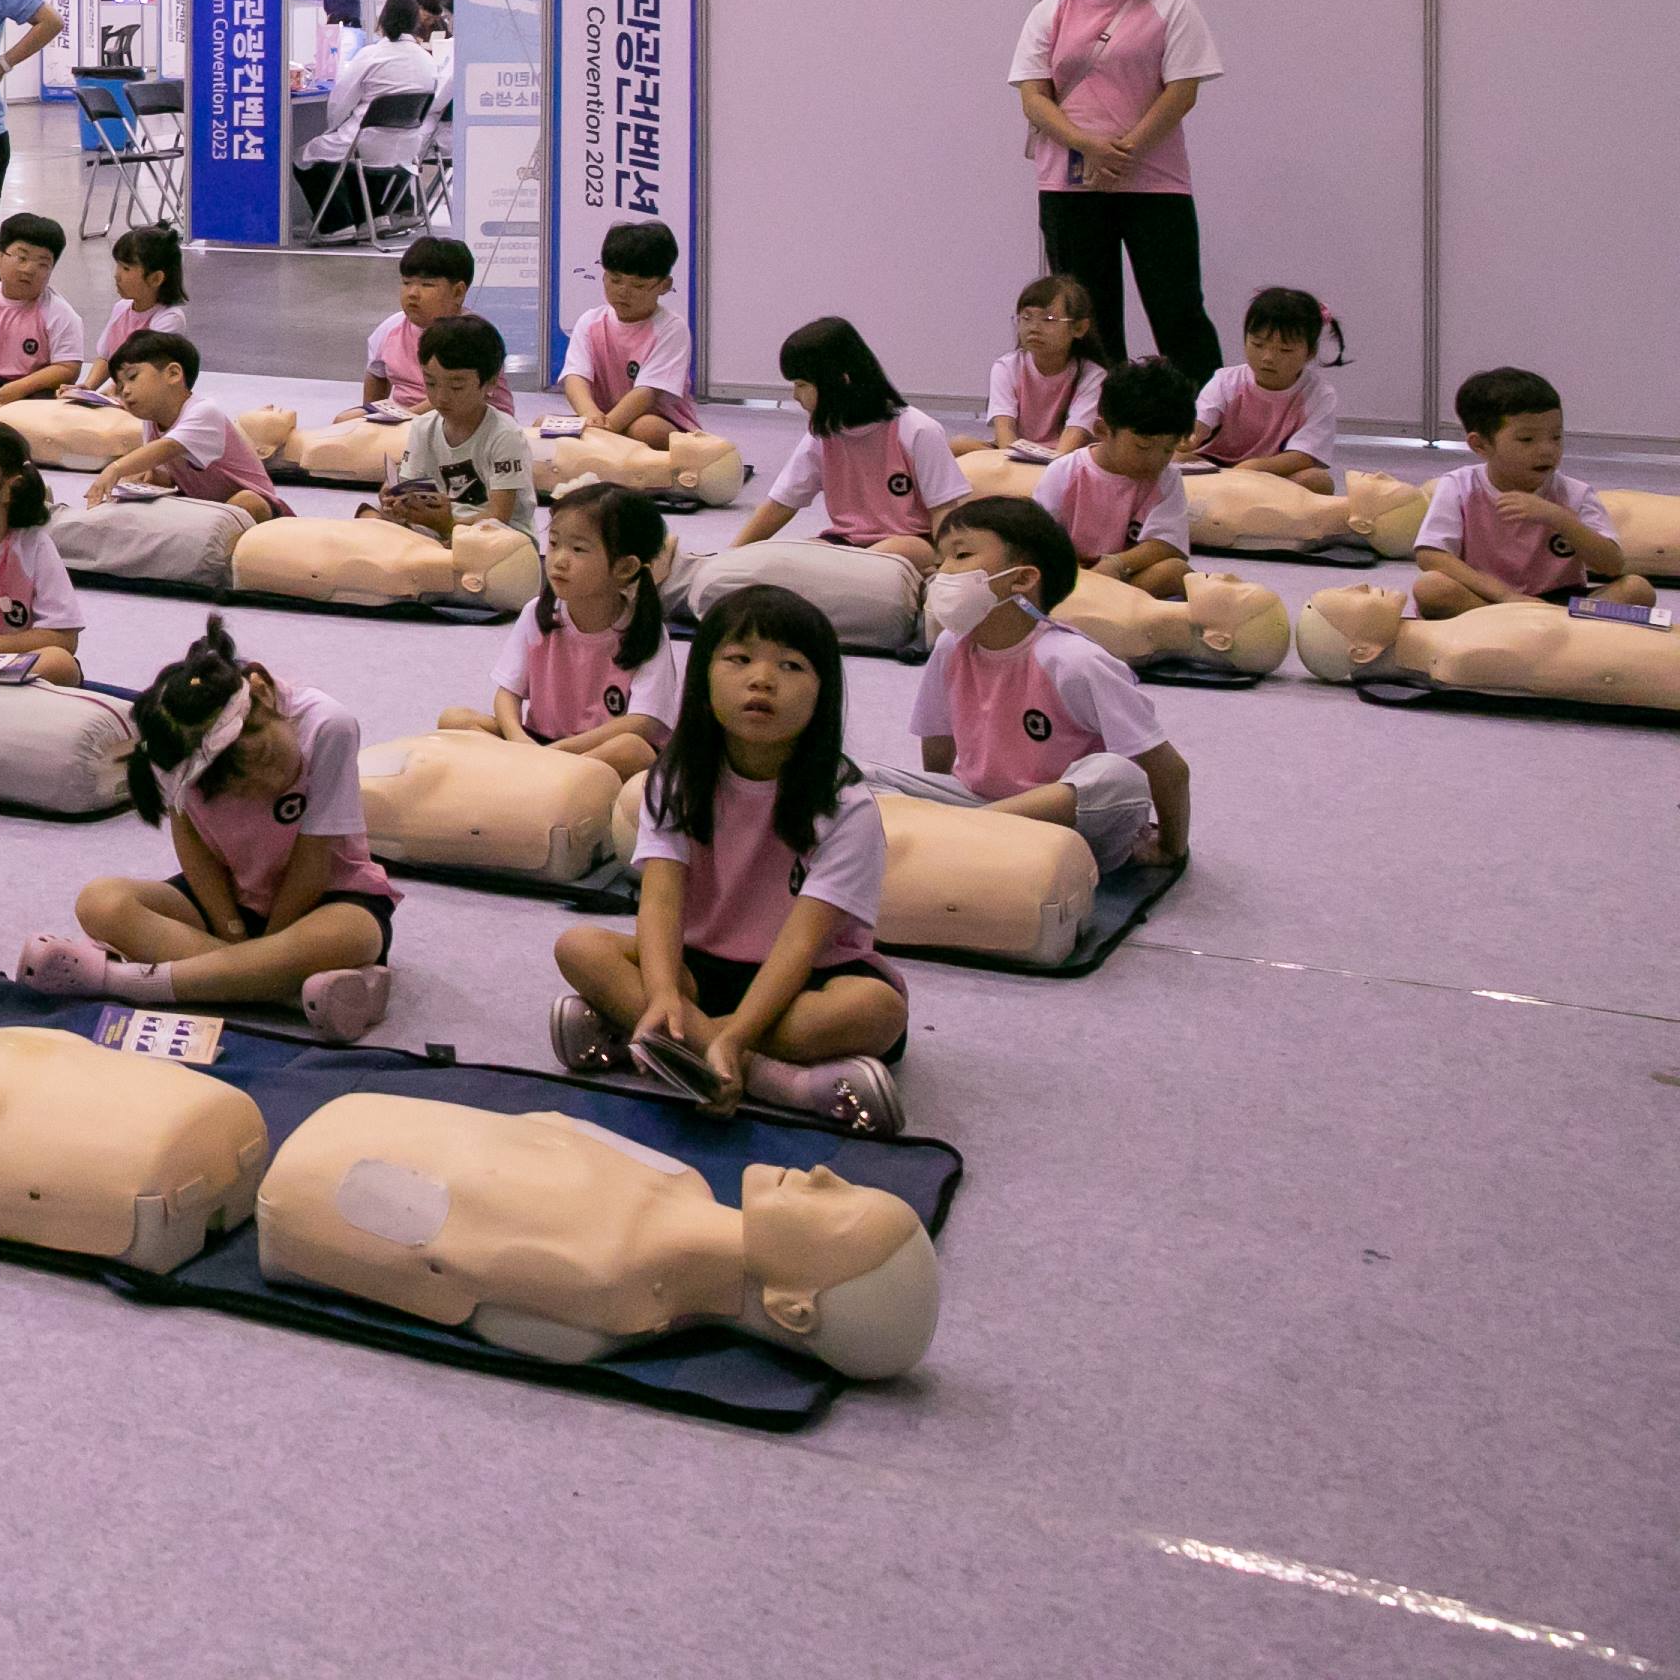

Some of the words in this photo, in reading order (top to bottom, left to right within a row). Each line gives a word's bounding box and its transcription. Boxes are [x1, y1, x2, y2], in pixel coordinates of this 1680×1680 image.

[212, 18, 228, 116] Convention
[586, 6, 606, 144] Convention
[212, 120, 228, 160] 2023
[585, 150, 604, 208] 2023
